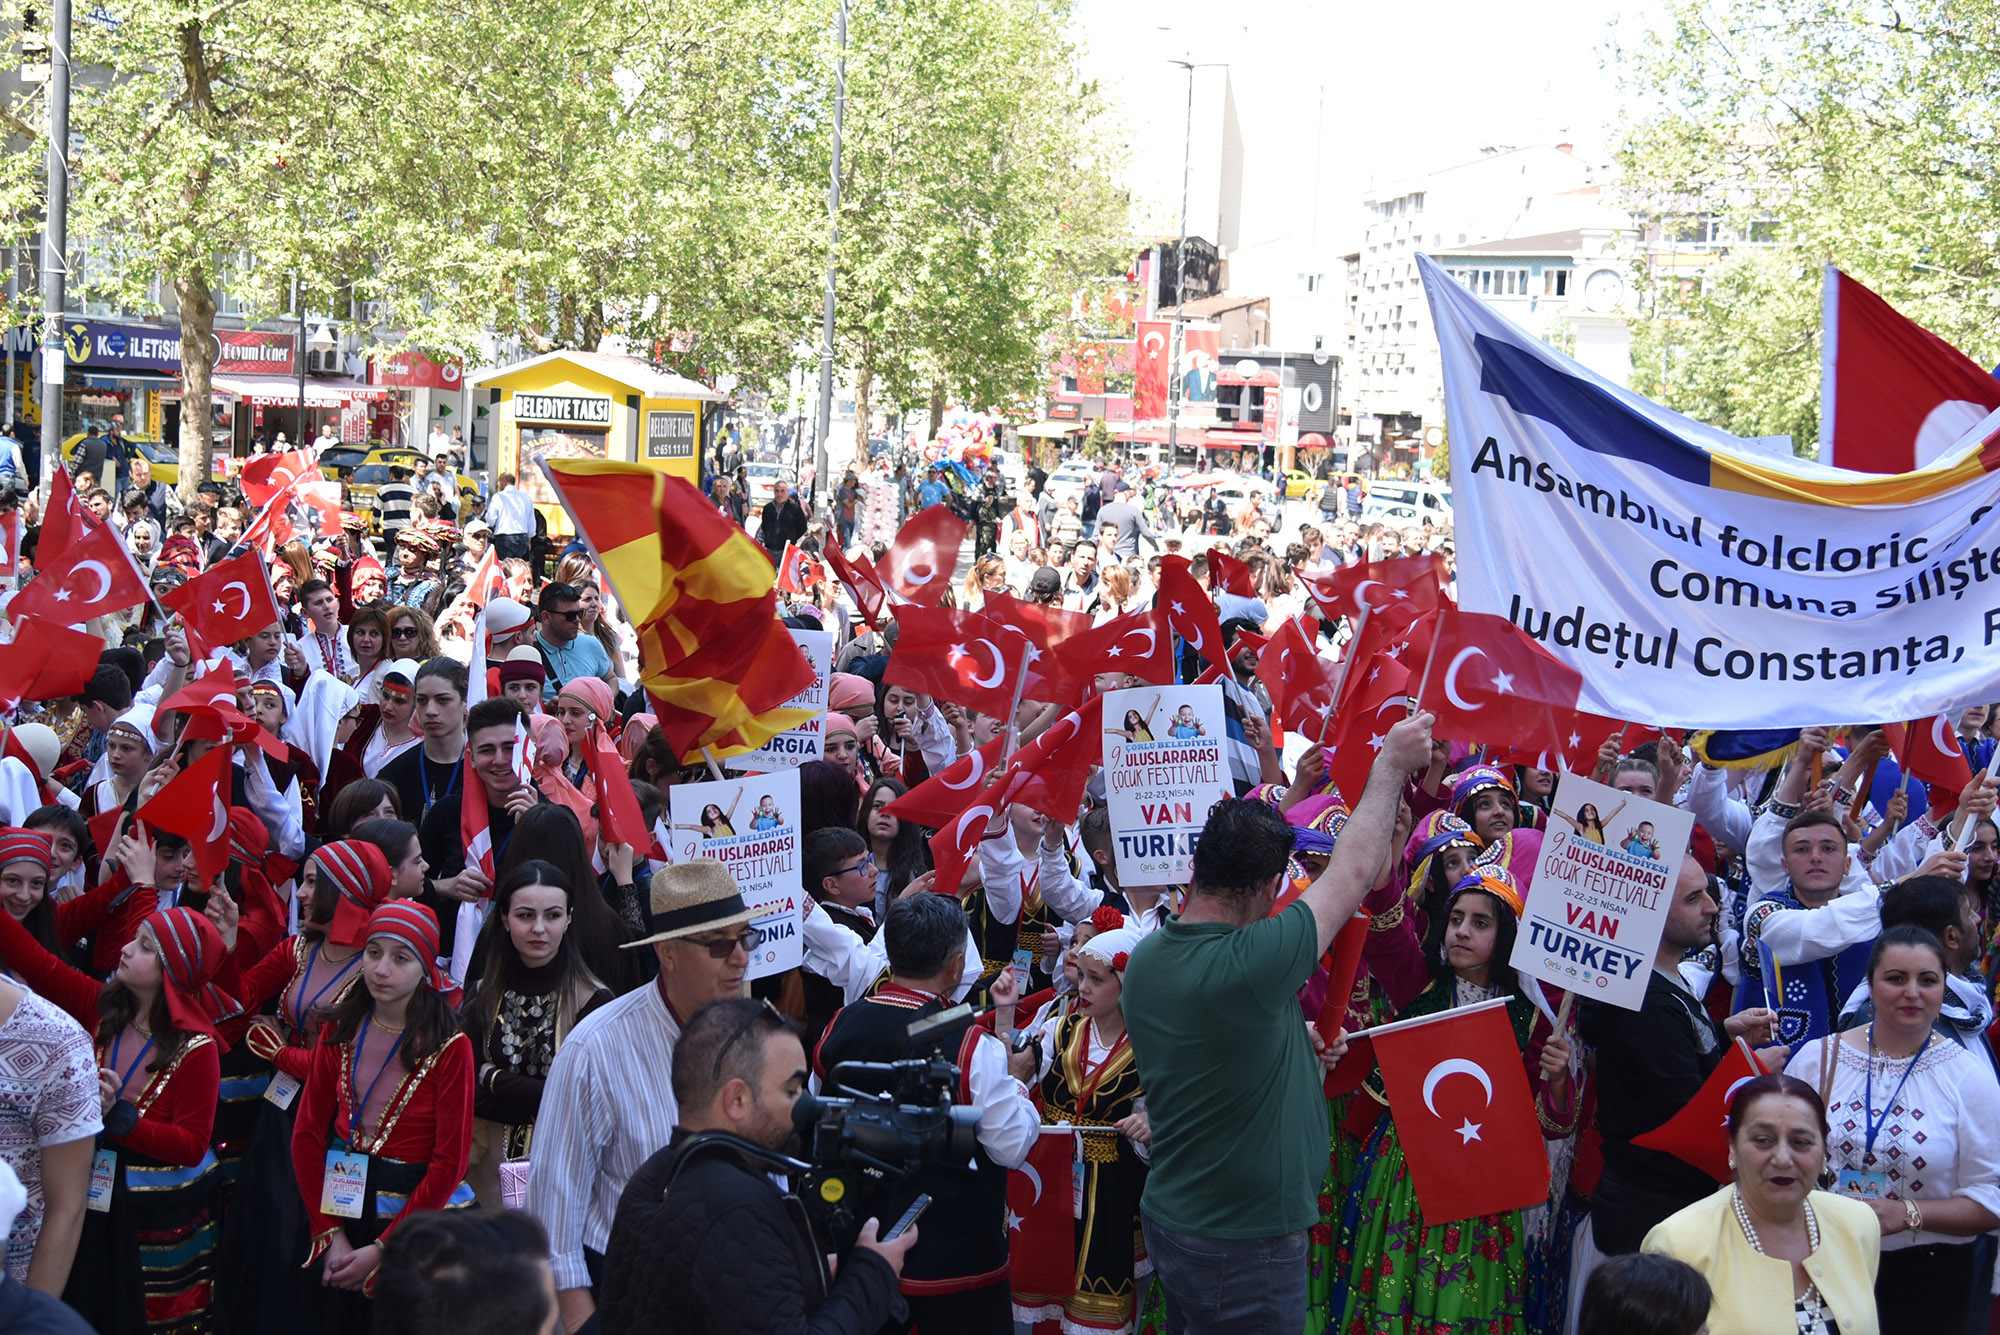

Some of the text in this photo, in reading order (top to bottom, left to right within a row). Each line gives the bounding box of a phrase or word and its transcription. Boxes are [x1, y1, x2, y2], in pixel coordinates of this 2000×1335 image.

[660, 444, 671, 455] 651
[1471, 436, 1702, 547] Ansamblul
[1718, 525, 1928, 572] folcloric
[1650, 559, 1856, 617] Comuna
[1125, 737, 1218, 753] ÇORLU BELEDİYESİ
[1126, 748, 1219, 768] ULUSLARARASI
[1112, 762, 1219, 794] ÇOCUK FESTİVALİ
[1141, 802, 1192, 825] VAN
[703, 835, 737, 849] ÇORLU
[1119, 832, 1200, 859] TURKE
[1570, 836, 1670, 875] ÇORLU BELEDİYESİ
[1543, 855, 1661, 911] ÇOCUK FESTİVALİ
[1566, 845, 1667, 891] ULUSLARARASI
[1563, 886, 1598, 906] 21-22-23
[1566, 902, 1619, 941] VAN
[1529, 920, 1643, 980] TURKEY
